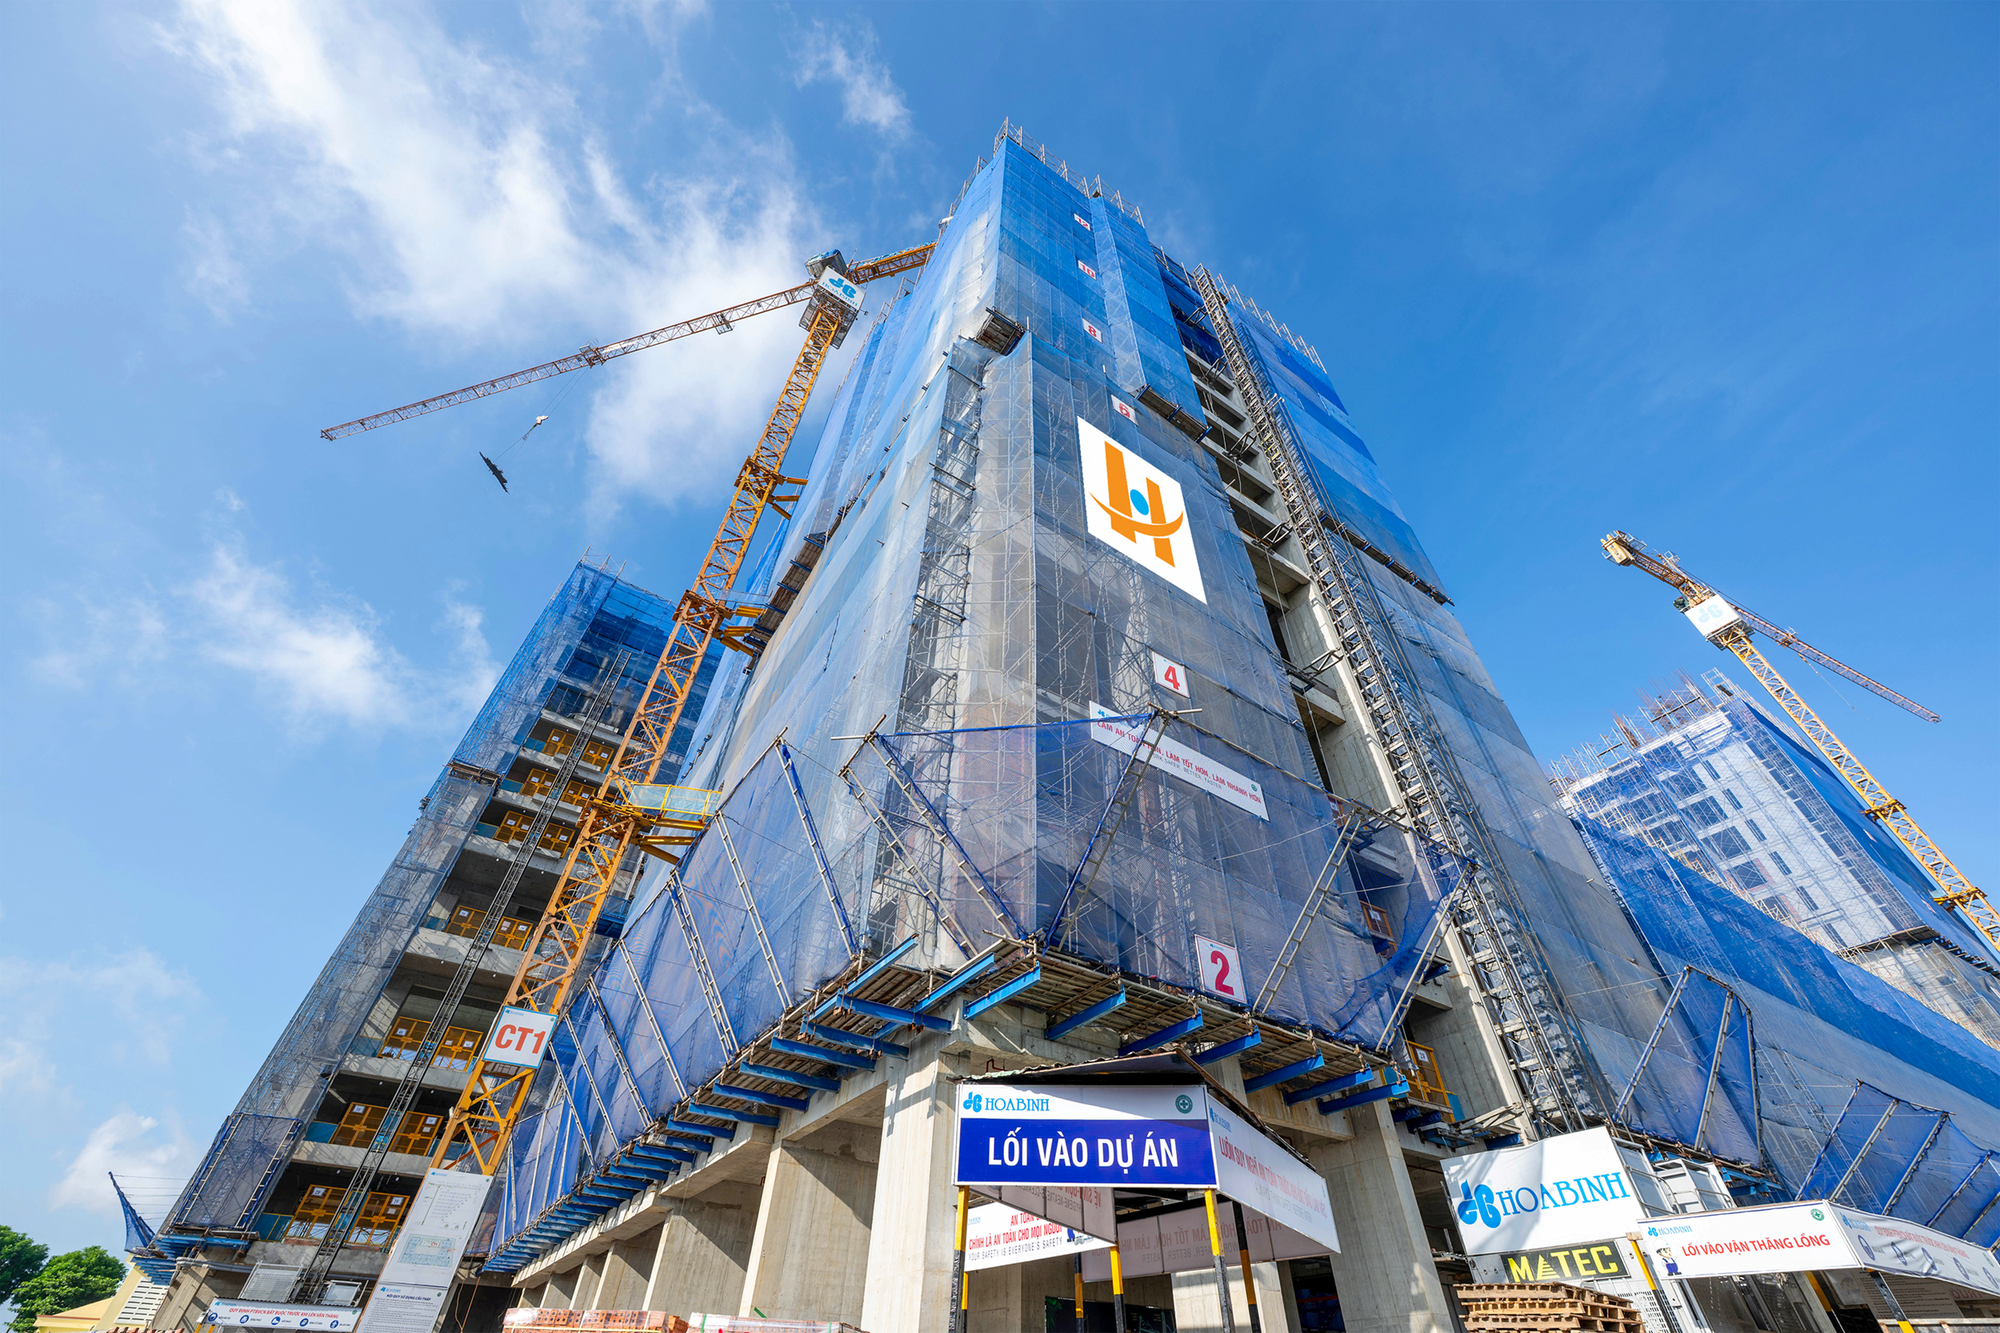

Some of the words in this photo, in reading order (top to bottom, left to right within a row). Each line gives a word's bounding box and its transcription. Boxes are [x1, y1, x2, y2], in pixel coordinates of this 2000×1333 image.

[1080, 263, 1095, 277] 10
[1088, 325, 1097, 337] 8
[1119, 402, 1131, 418] 6
[1164, 665, 1181, 690] 4
[1115, 727, 1125, 738] AN
[1165, 750, 1180, 763] LÀM
[1181, 757, 1193, 769] TỐT
[1212, 773, 1226, 786] LÀM
[1226, 780, 1248, 797] NHANH
[1210, 950, 1235, 996] 2
[494, 1024, 547, 1055] CT1
[984, 1097, 1050, 1112] HOABINH
[988, 1127, 1028, 1167] LỐI
[1036, 1130, 1089, 1168] VÀO
[1097, 1134, 1134, 1175] DỰ
[1142, 1131, 1179, 1168] ÁN
[1234, 1146, 1246, 1169] SUY
[1495, 1172, 1631, 1216] HOABINH
[1010, 1214, 1019, 1227] AN
[1657, 1225, 1693, 1235] HOABINH
[968, 1235, 985, 1250] CHÍNH
[985, 1233, 992, 1248] LÀ
[993, 1234, 1002, 1246] AN
[1002, 1229, 1017, 1244] TOÀN
[1018, 1227, 1030, 1242] CHO
[1031, 1225, 1042, 1240] MỌI
[981, 1248, 999, 1260] SAFETY
[1000, 1247, 1006, 1257] IS
[1008, 1240, 1041, 1256] EVERYONE'S
[1042, 1236, 1063, 1250] SAFETY
[1682, 1242, 1701, 1257] LỐI
[1700, 1241, 1725, 1255] VÀO
[1723, 1239, 1750, 1255] VẬN
[1749, 1236, 1794, 1252] THĂNG
[1507, 1246, 1619, 1283] MATEC
